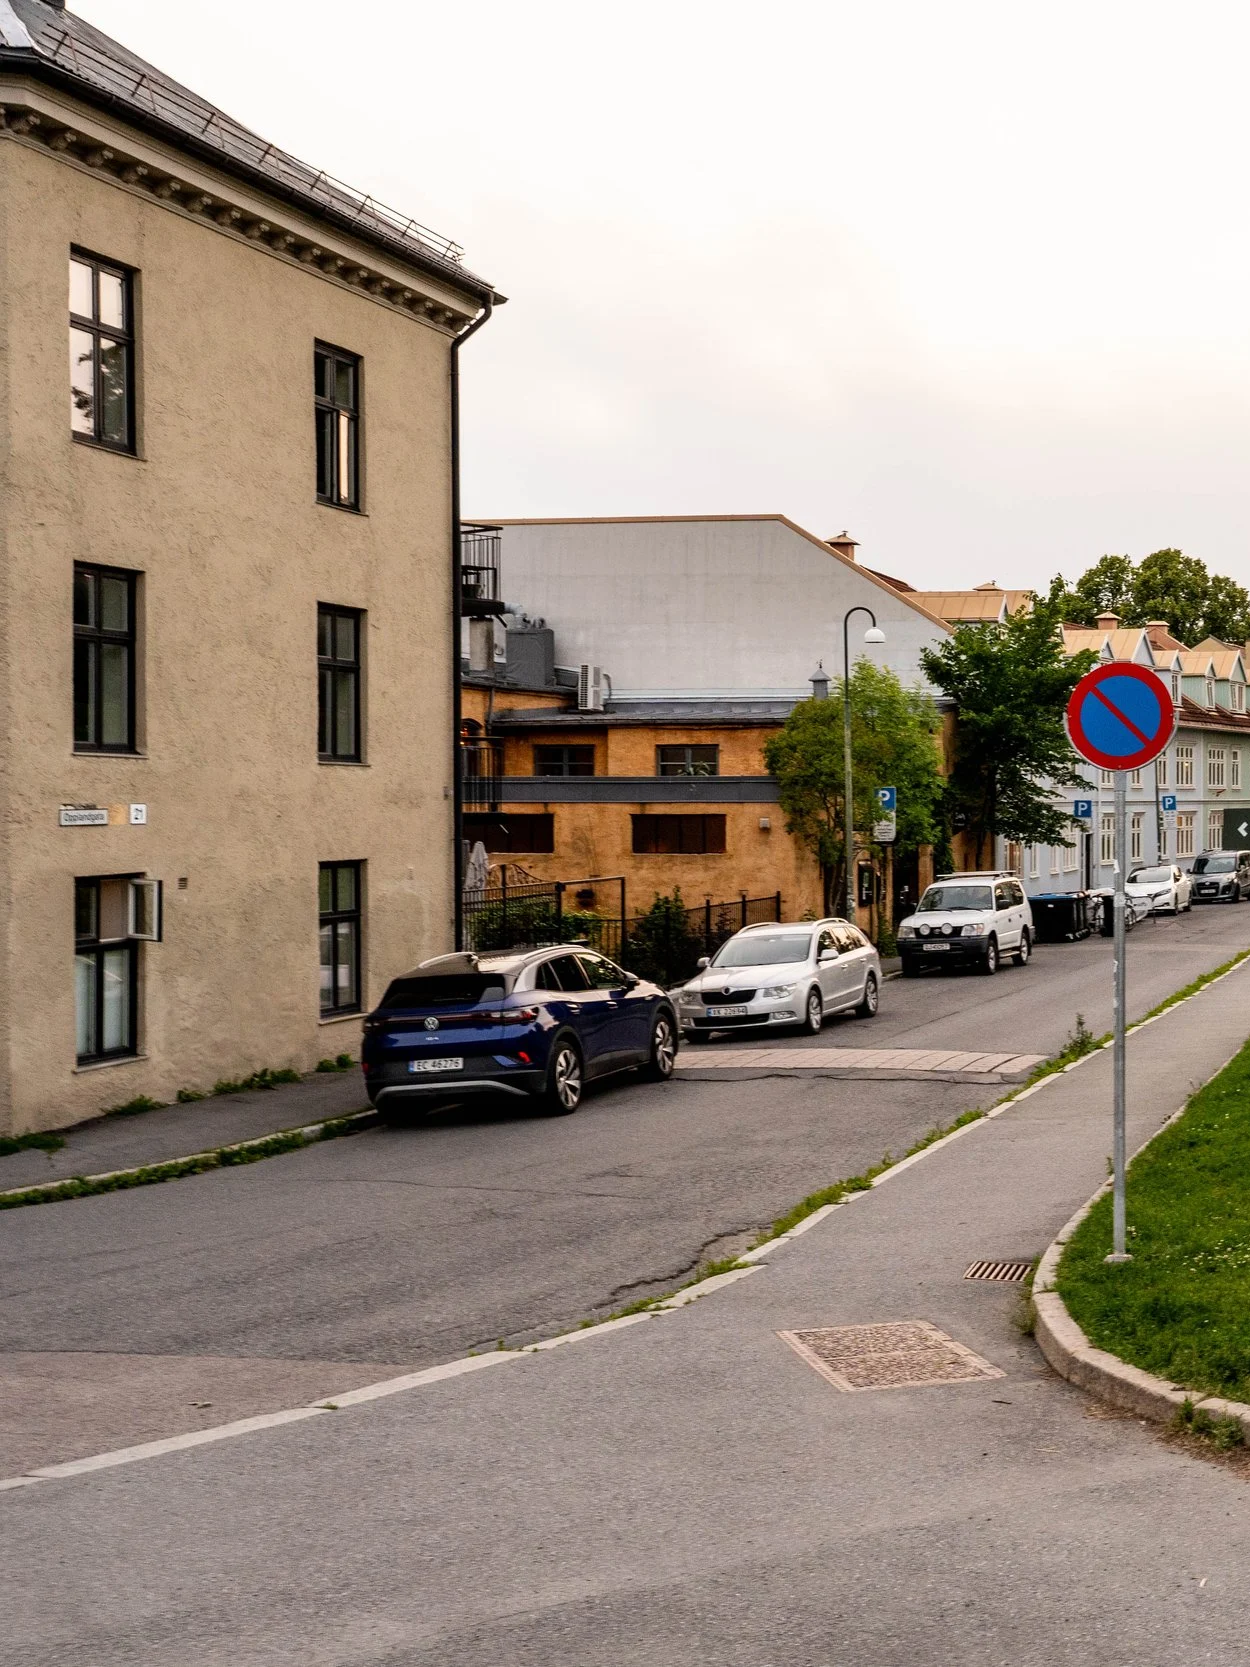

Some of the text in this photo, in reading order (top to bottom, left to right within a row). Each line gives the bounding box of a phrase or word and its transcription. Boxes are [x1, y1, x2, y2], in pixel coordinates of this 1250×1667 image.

[879, 790, 890, 806] P
[1165, 797, 1174, 809] P
[1077, 802, 1088, 816] P
[416, 1058, 461, 1070] EC 46276
